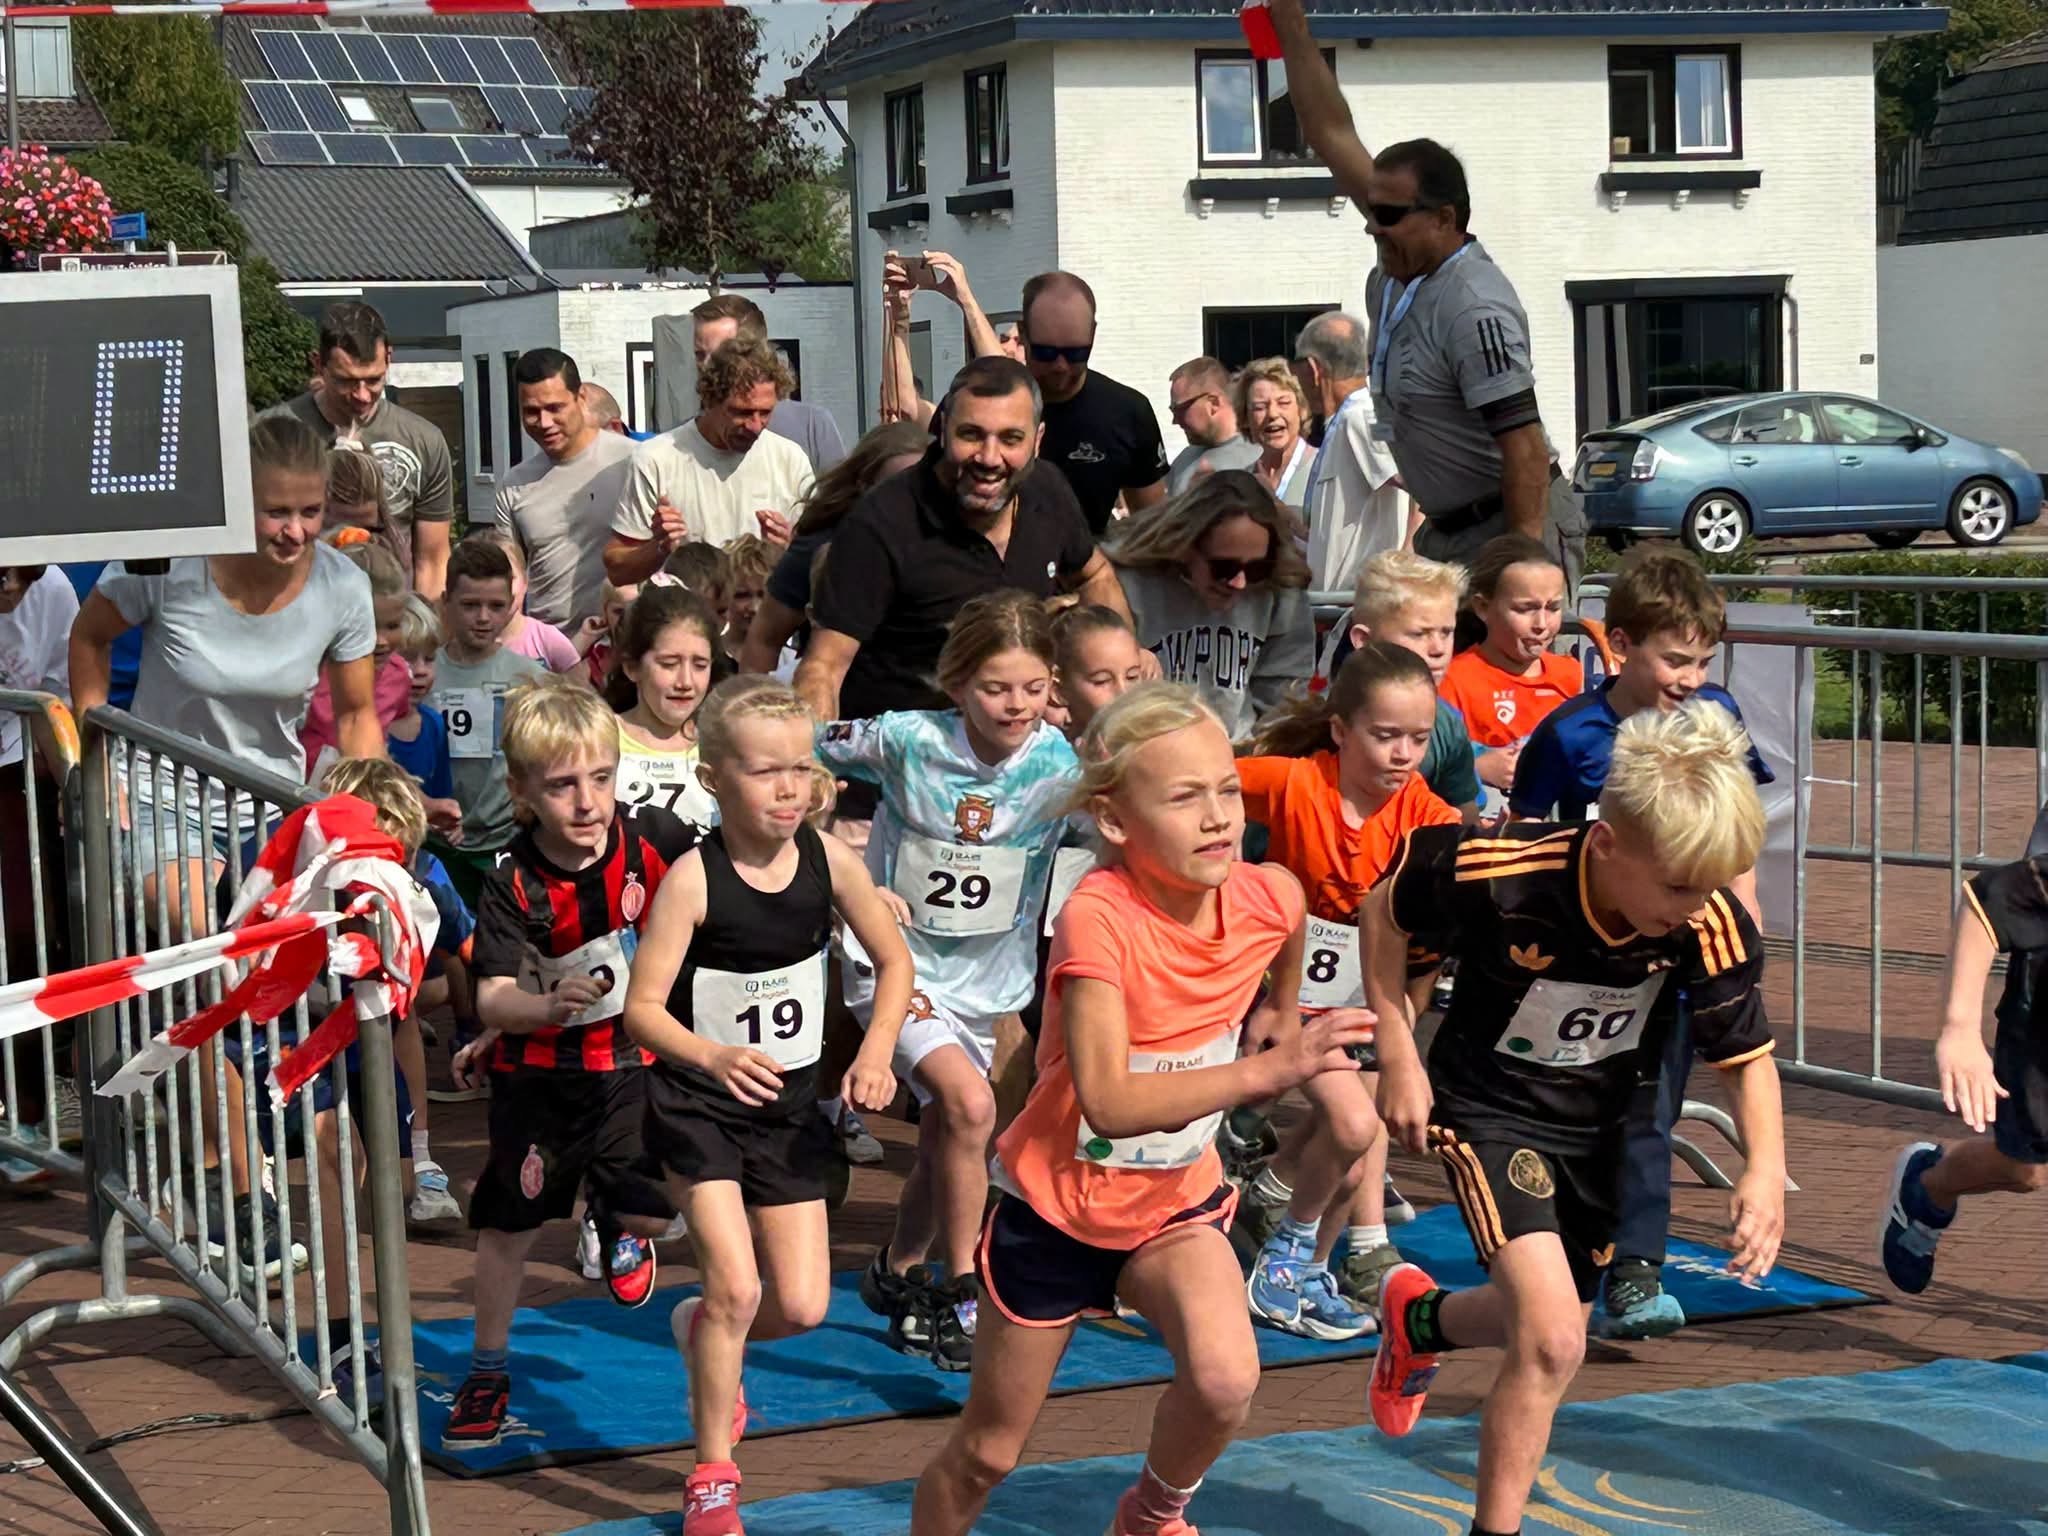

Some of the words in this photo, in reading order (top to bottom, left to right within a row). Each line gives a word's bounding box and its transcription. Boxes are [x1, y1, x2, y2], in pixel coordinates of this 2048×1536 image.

[90, 339, 184, 494] 0
[1150, 625, 1264, 690] WPOR
[628, 781, 686, 810] 27
[924, 870, 991, 910] 29
[1306, 948, 1340, 983] 8
[735, 998, 803, 1044] 19
[1557, 1007, 1636, 1042] 60
